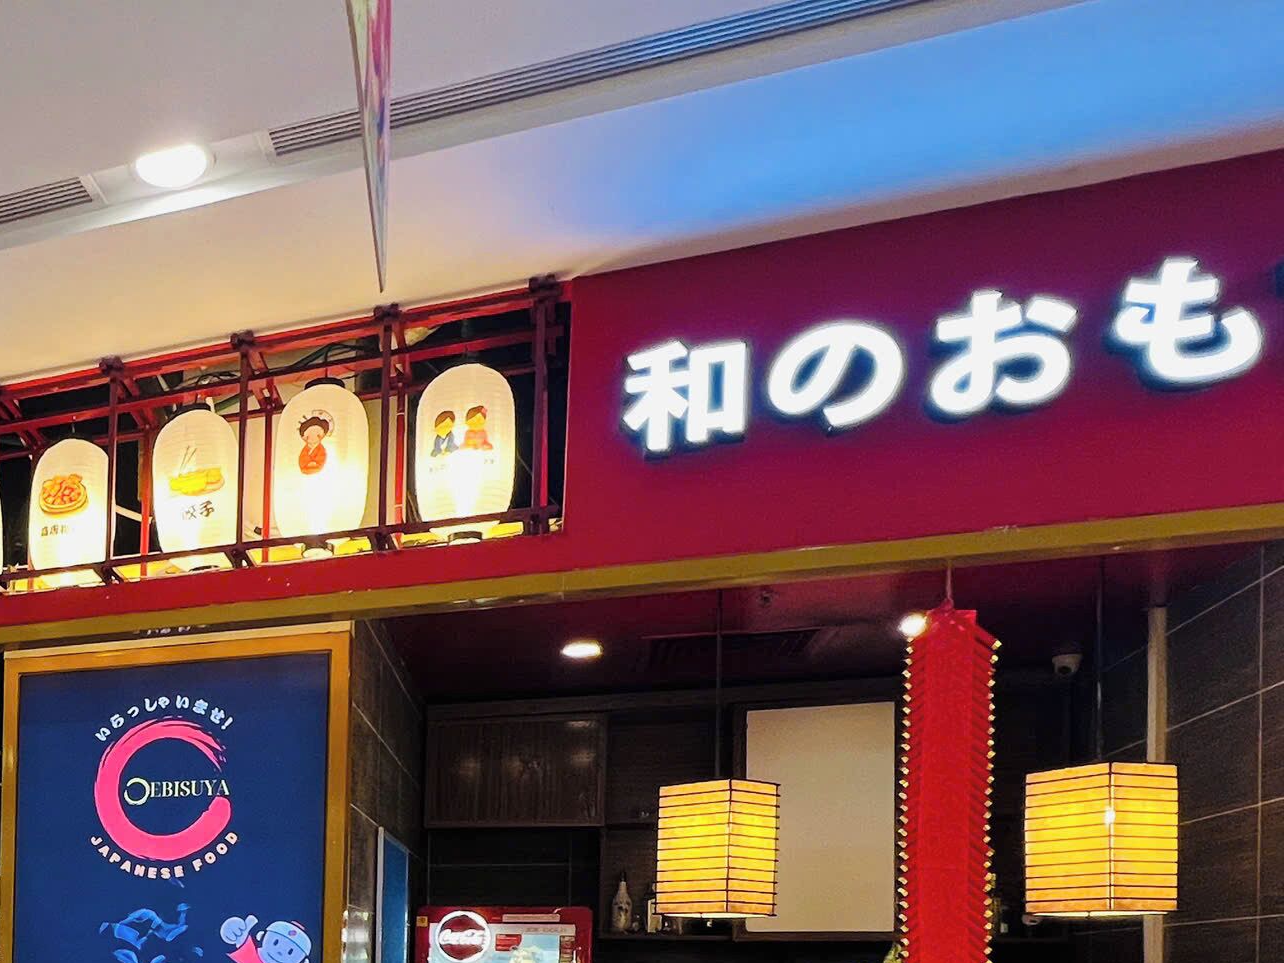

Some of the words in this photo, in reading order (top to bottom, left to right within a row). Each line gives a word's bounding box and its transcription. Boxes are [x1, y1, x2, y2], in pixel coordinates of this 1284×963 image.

[123, 777, 230, 806] OEBISUYA
[90, 836, 185, 880] JAPANESE
[192, 832, 239, 872] FOOD
